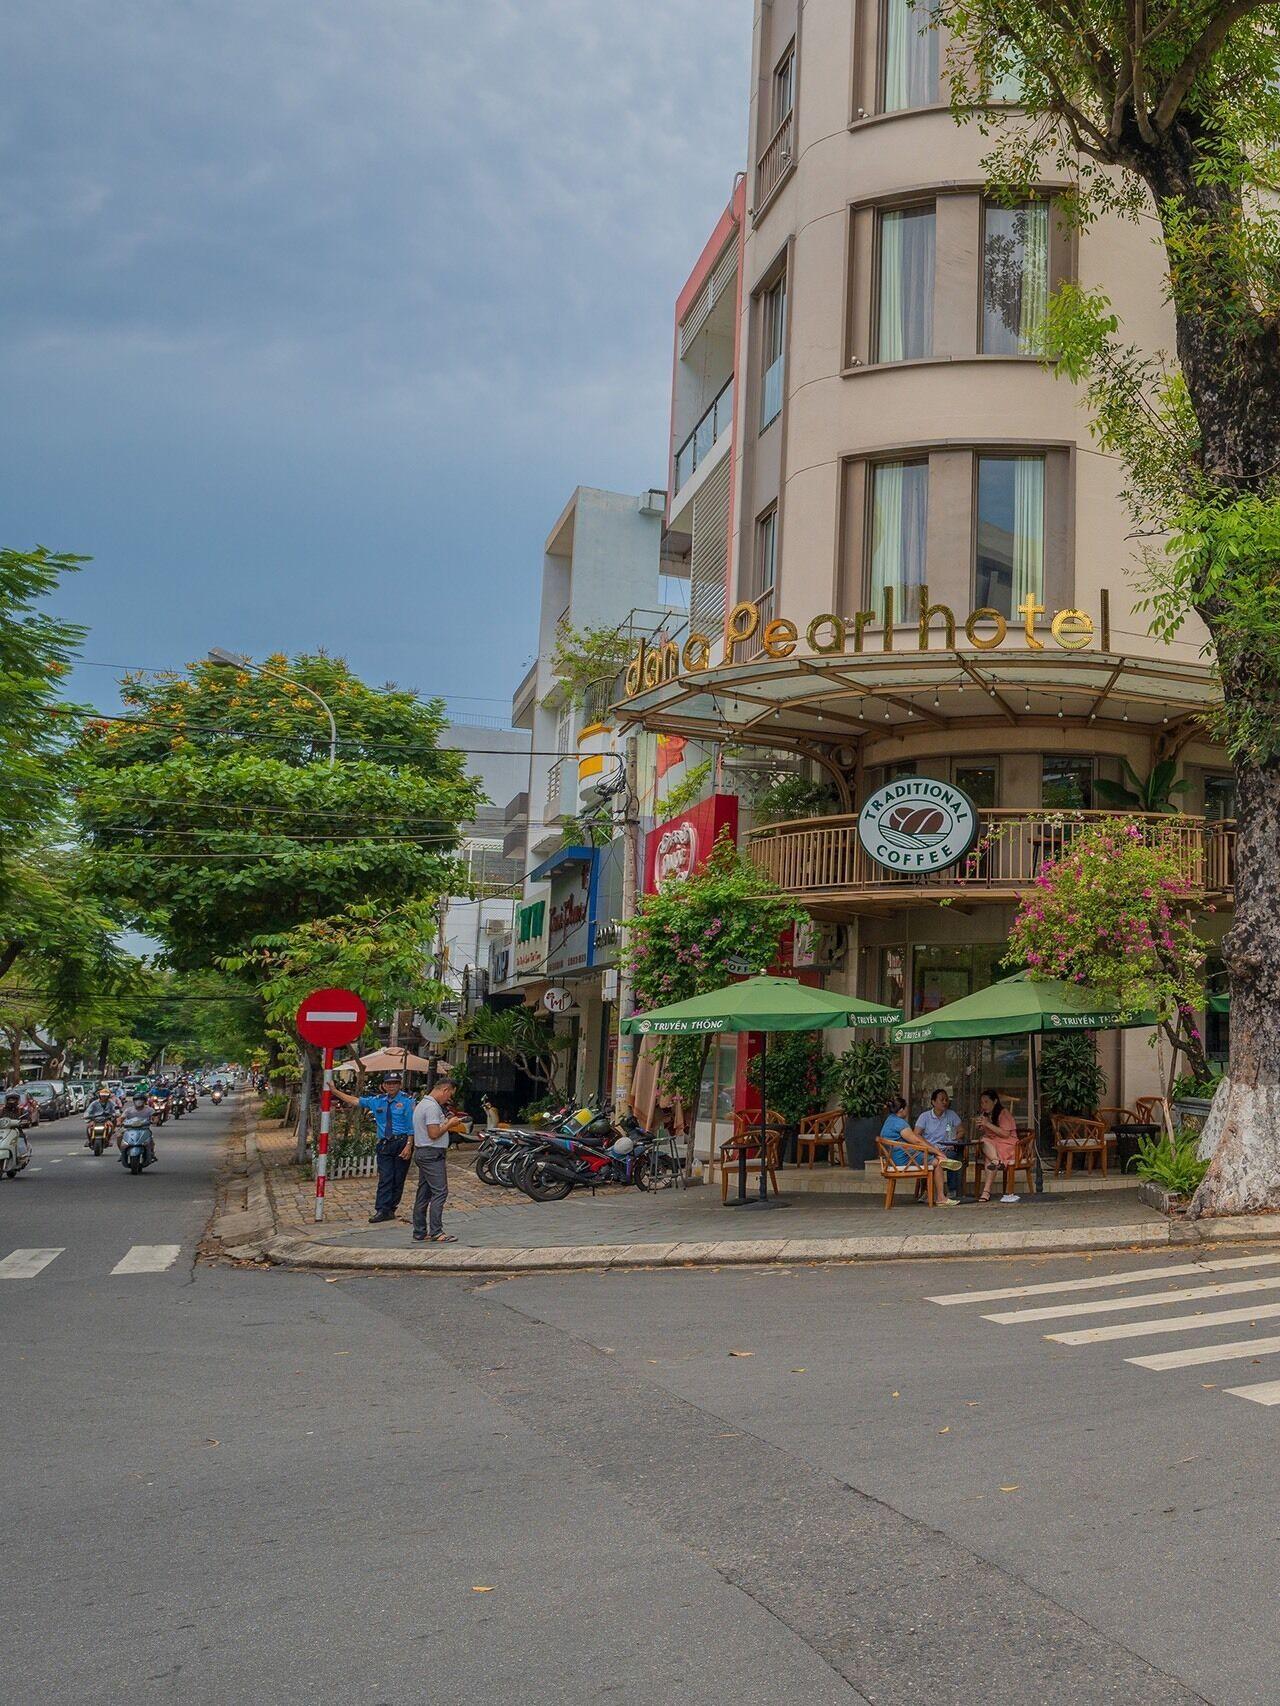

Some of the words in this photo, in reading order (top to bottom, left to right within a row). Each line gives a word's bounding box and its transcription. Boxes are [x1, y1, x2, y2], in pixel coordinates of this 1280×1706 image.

[626, 633, 709, 696] dana
[725, 584, 893, 665] Pearl
[919, 585, 1110, 651] hotel
[864, 782, 968, 823] TRADITIONAL
[876, 844, 953, 866] COFFEE
